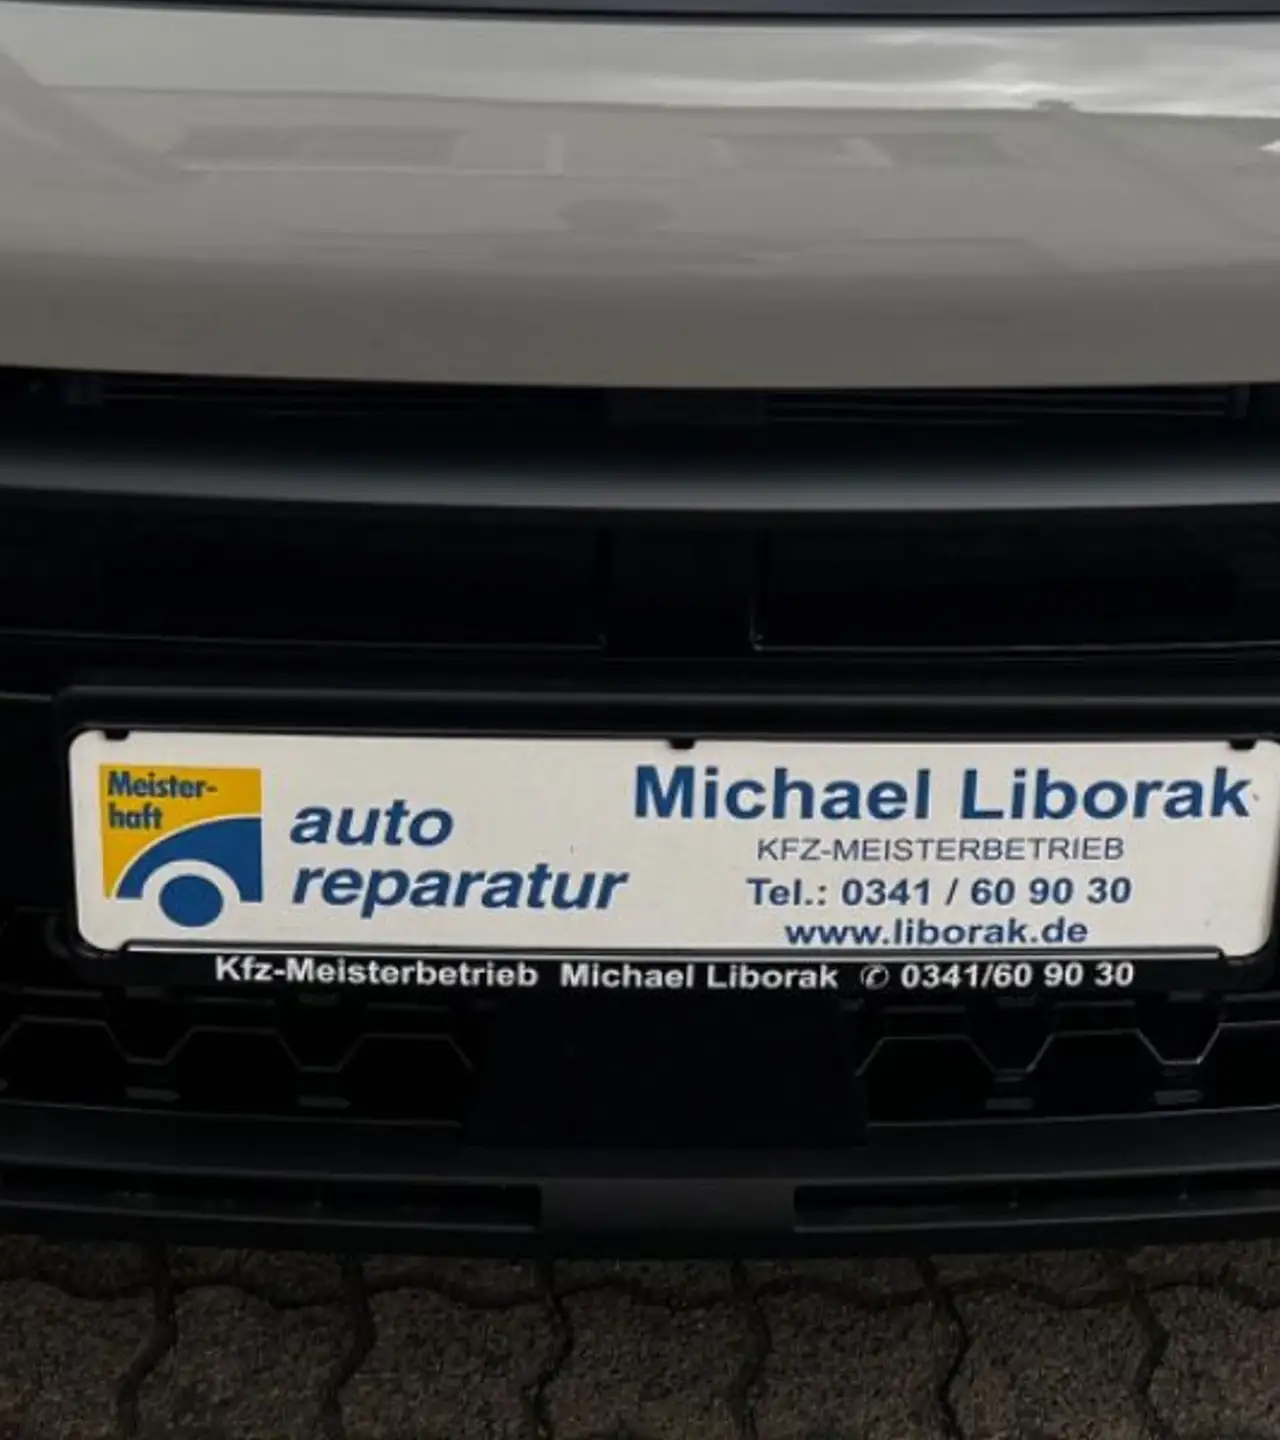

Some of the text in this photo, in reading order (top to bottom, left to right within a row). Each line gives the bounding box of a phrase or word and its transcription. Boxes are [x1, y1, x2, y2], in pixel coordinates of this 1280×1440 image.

[107, 770, 218, 799] Meister-
[634, 765, 1252, 820] Michael Liborak
[109, 802, 163, 830] haft
[289, 799, 454, 846] auto
[757, 837, 1125, 862] KFZ-MEISTERBETRIEB
[291, 863, 630, 920] reparatur
[746, 877, 828, 906] Tel.:
[841, 878, 931, 906] 0341
[970, 877, 1016, 906] 60
[1028, 877, 1074, 905] 90
[1087, 876, 1132, 904] 30
[784, 917, 1089, 945] www.liborak.de
[215, 956, 1135, 990] Kfz-Meisterbetrieb Michael Liborak 0341/60 90 30
